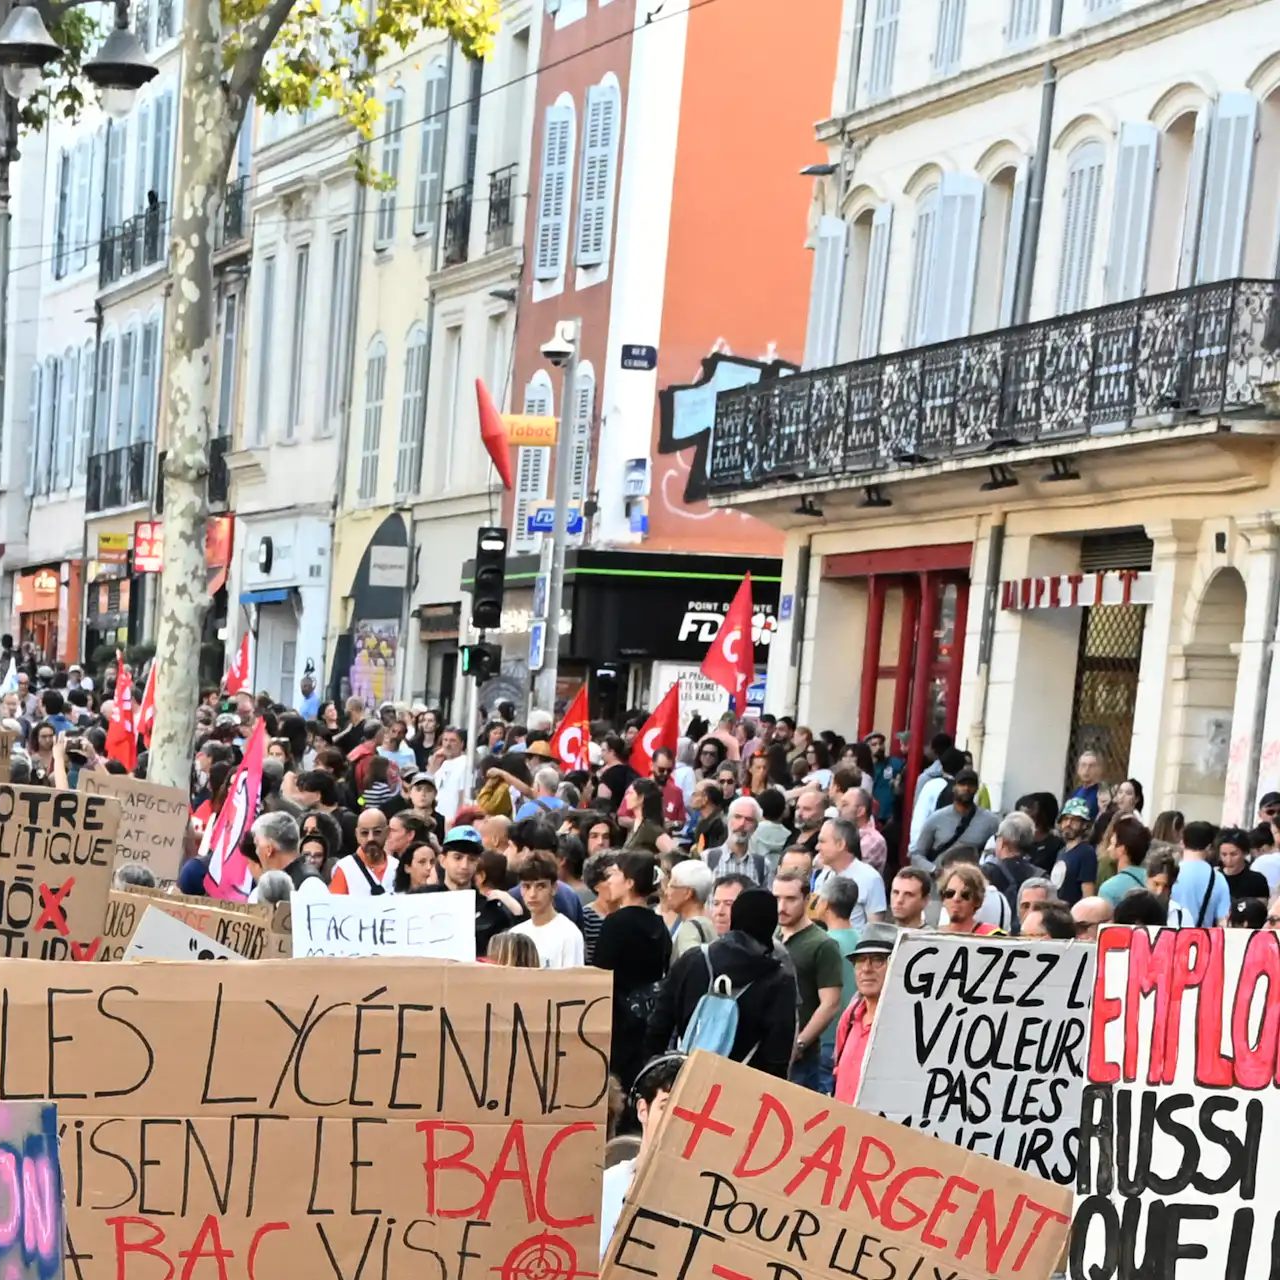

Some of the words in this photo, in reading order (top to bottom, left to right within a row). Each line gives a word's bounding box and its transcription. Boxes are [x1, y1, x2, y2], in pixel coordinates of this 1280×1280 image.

[508, 424, 552, 437] Tabac
[678, 612, 726, 642] FD
[688, 601, 718, 611] POINT
[120, 811, 147, 823] OUR
[115, 844, 151, 862] POUR
[103, 900, 136, 938] OUS
[903, 945, 1061, 1009] GAZEZ
[1088, 926, 1280, 1091] EMPLO
[0, 985, 156, 1101] LES
[200, 983, 612, 1117] LYCÉEN.NES
[912, 1000, 1086, 1078] ViOLEUR
[923, 1067, 993, 1125] PAS
[1000, 1077, 1070, 1126] LES
[58, 1113, 290, 1218] iSENT
[306, 1115, 389, 1217] LE
[415, 1118, 597, 1230] BAC
[1077, 1083, 1265, 1200] AUSSI
[731, 1092, 1072, 1275] D'ARGENT
[699, 1171, 821, 1261] POUR
